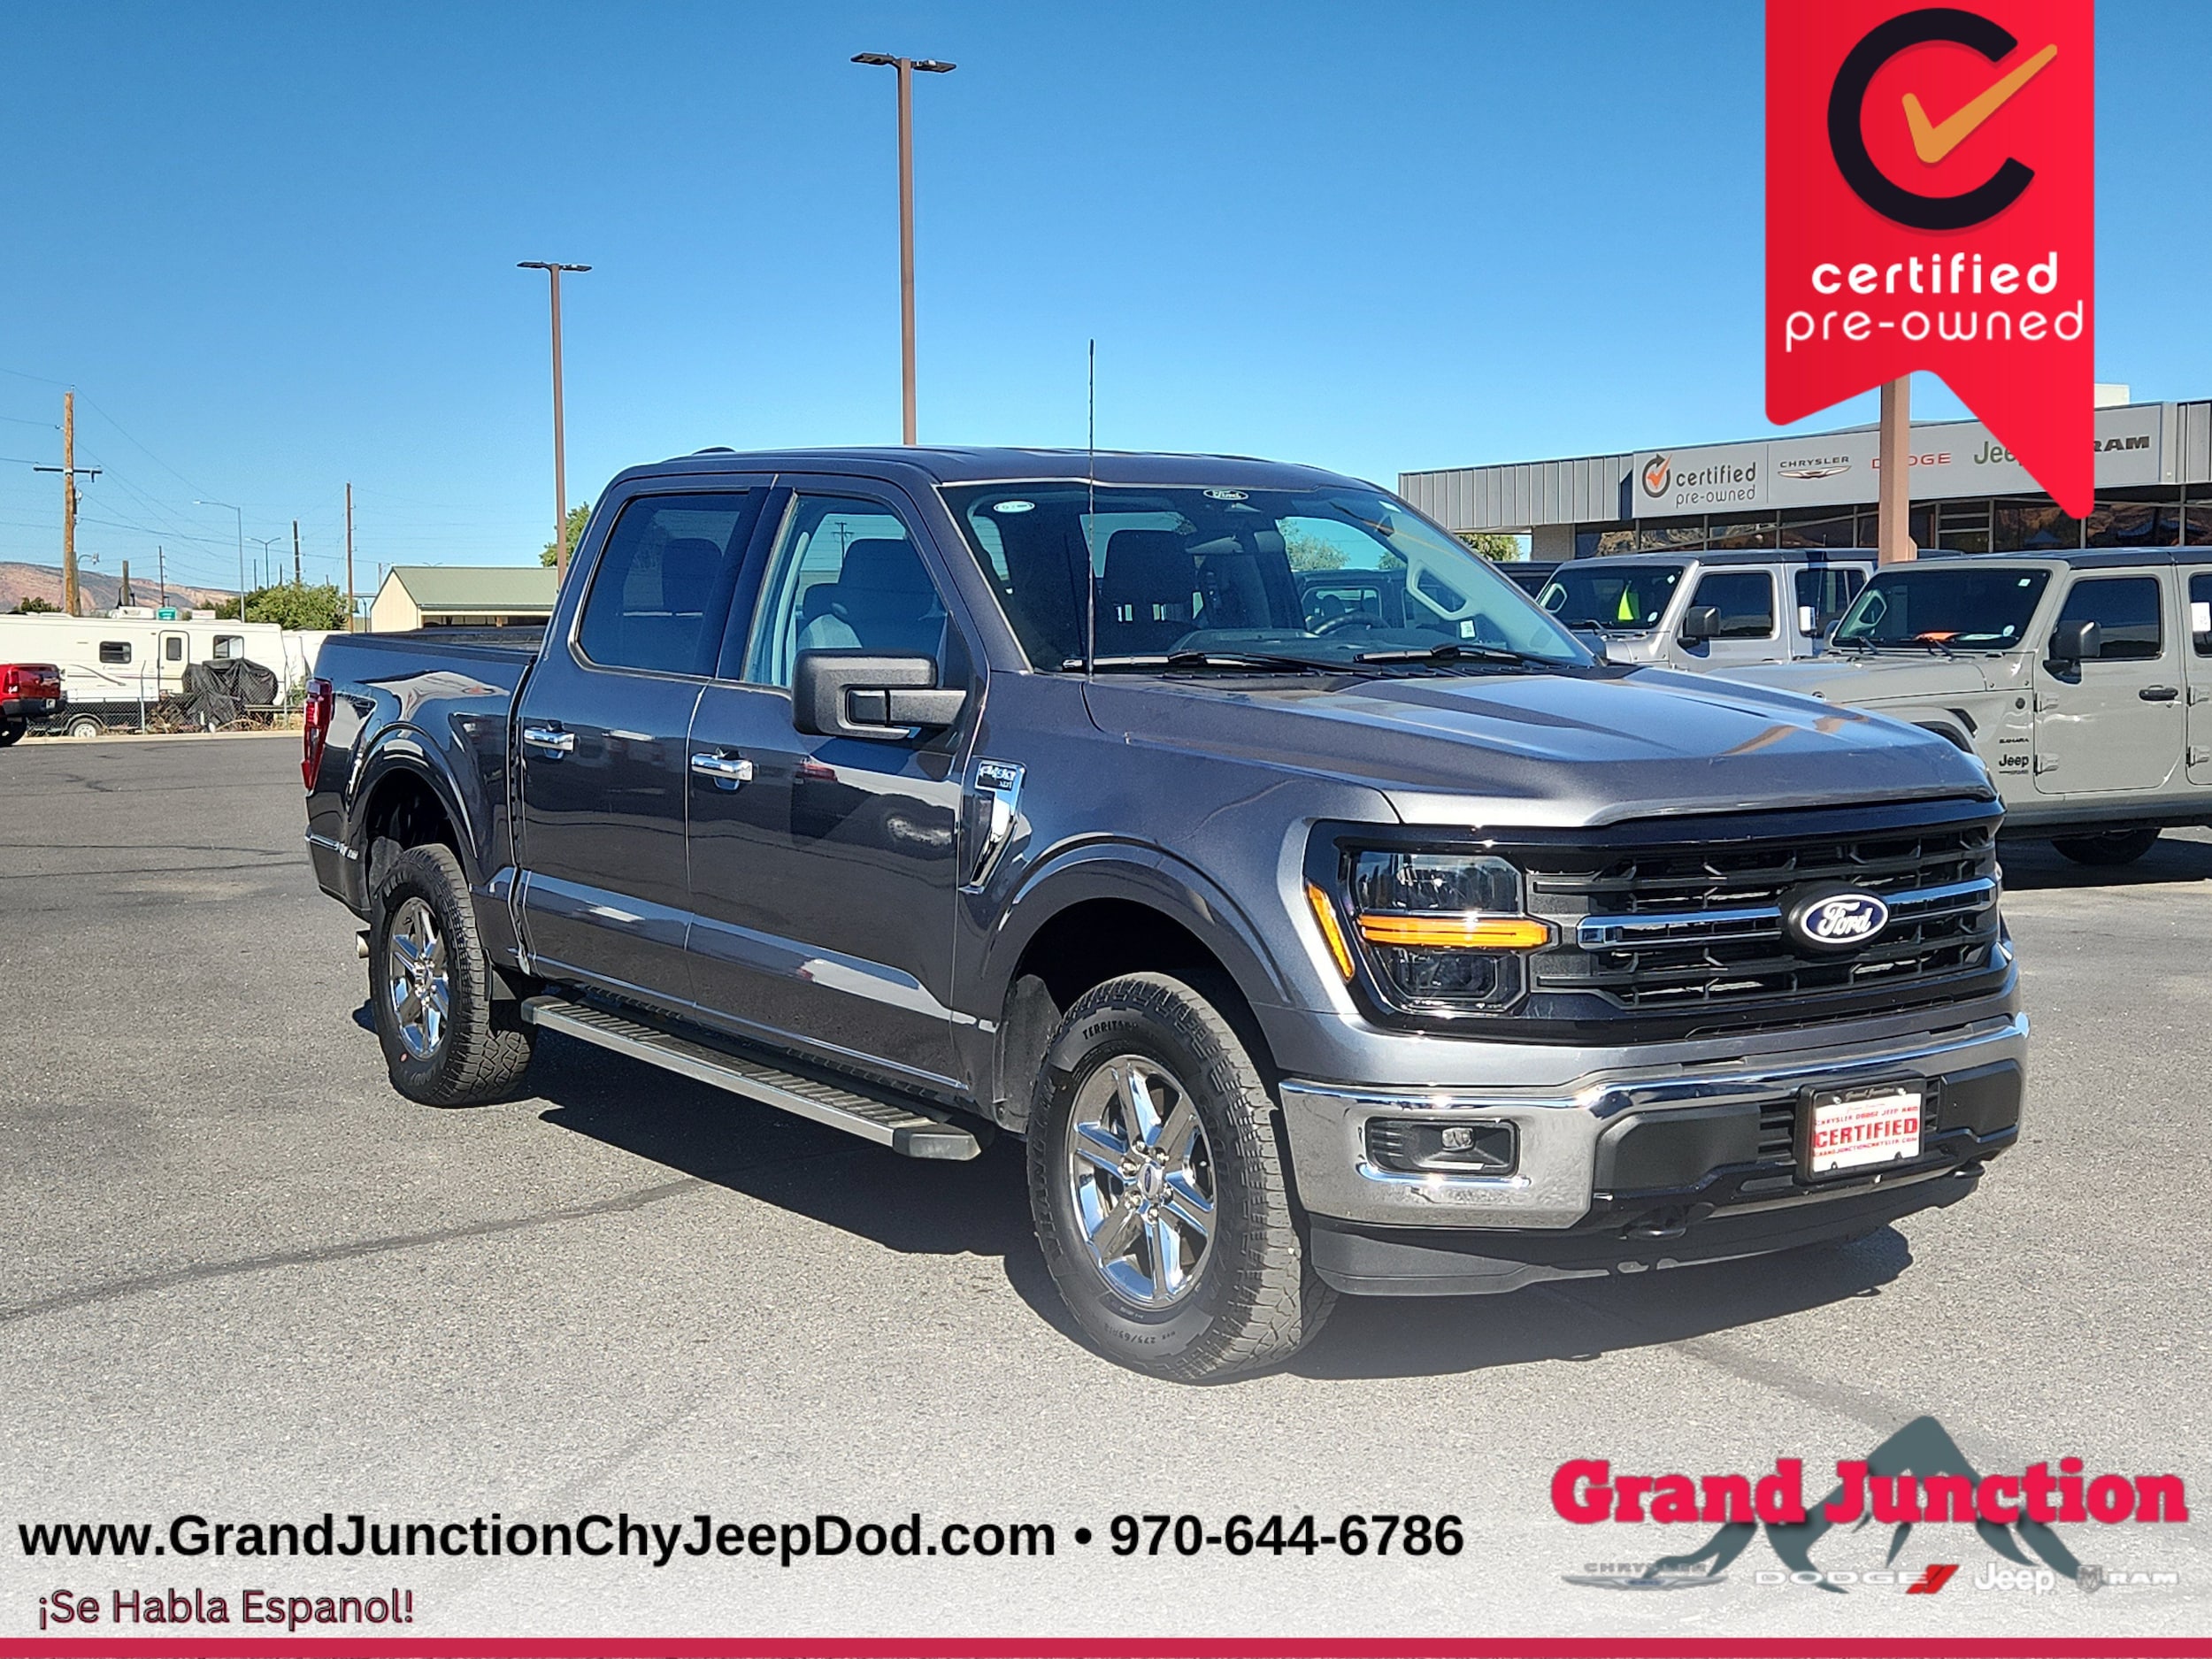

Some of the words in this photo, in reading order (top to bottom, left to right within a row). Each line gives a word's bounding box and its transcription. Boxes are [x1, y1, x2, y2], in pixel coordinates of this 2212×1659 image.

[1779, 455, 1850, 469] CHRYSLER
[1871, 452, 1952, 469] DDGE
[1974, 441, 2022, 466] Jee
[1676, 462, 1756, 488] certified
[1676, 484, 1756, 509] pre-owned
[1999, 754, 2030, 768] Jeep
[1816, 901, 1874, 937] Ford
[1815, 1118, 1918, 1148] CERTIFIED
